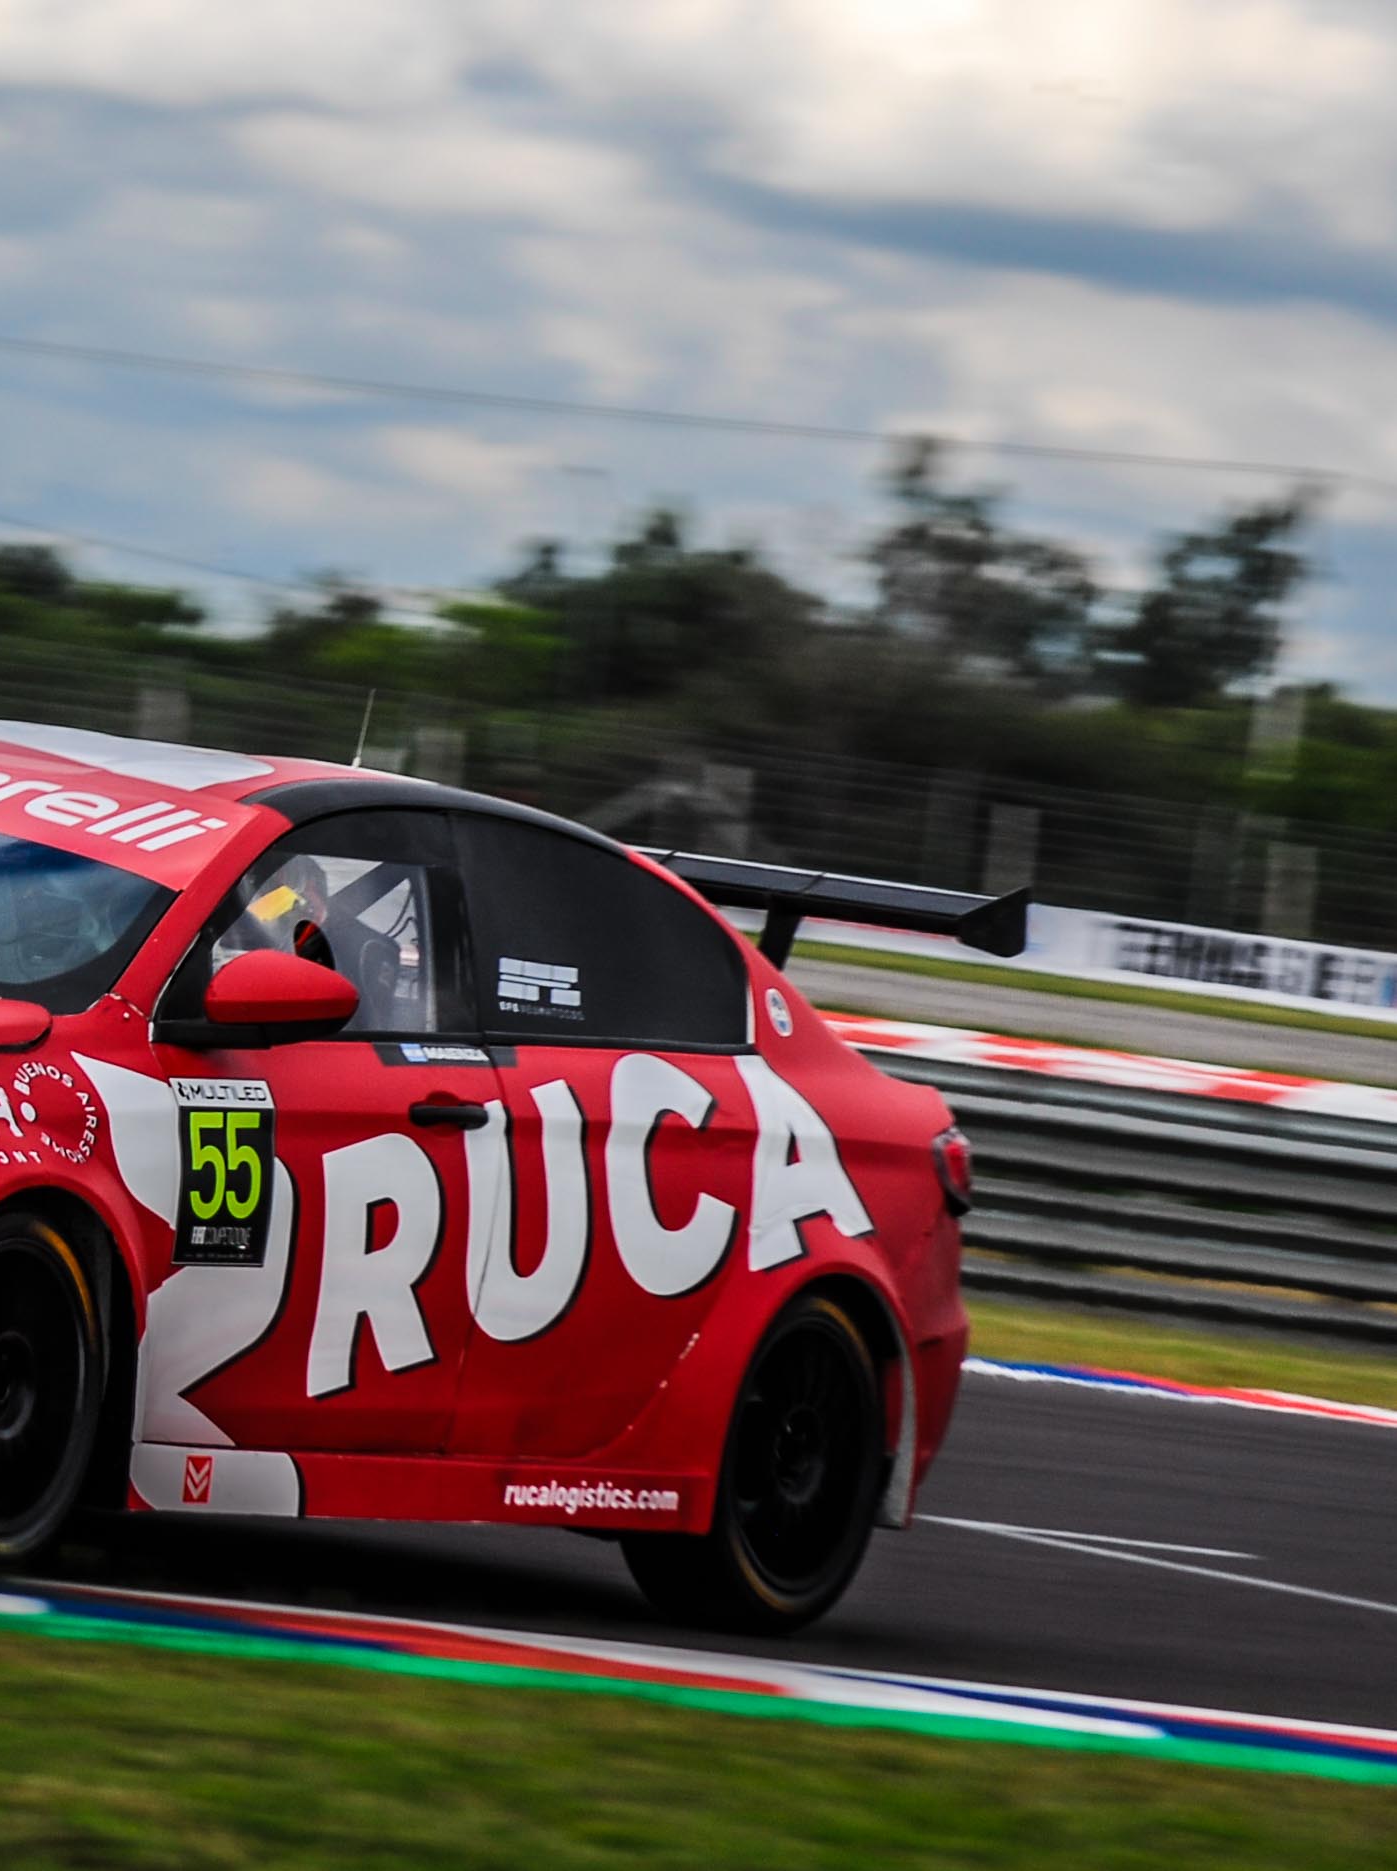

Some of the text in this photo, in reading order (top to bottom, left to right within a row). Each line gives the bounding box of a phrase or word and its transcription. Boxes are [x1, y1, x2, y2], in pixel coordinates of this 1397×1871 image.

[13, 1062, 73, 1096] BUENOS
[75, 1091, 97, 1156] AIRES
[189, 1084, 267, 1101] MULTILED
[190, 1111, 261, 1219] 55
[306, 1053, 874, 1398] RUCA
[504, 1480, 679, 1515] rucalogistics.com
